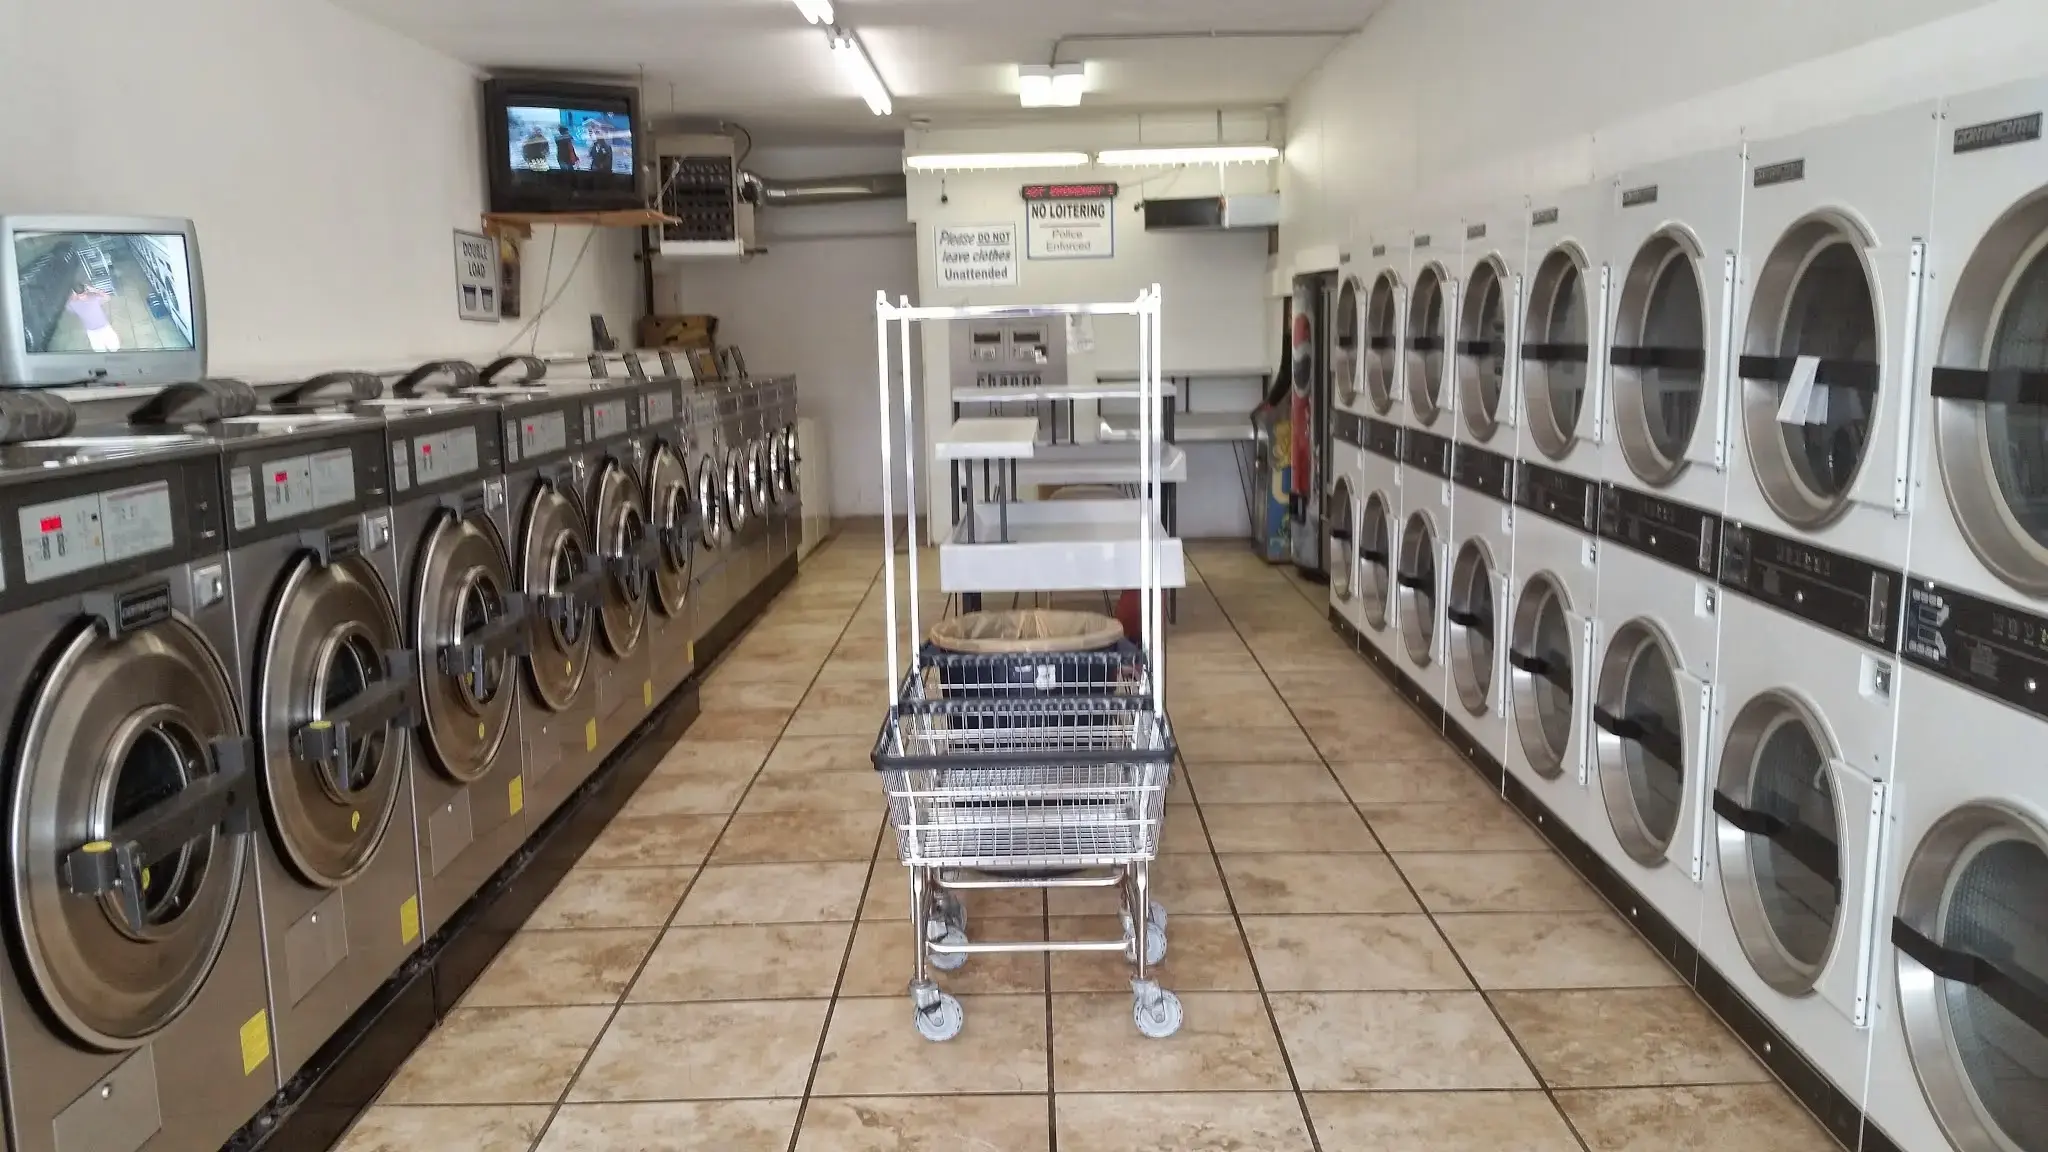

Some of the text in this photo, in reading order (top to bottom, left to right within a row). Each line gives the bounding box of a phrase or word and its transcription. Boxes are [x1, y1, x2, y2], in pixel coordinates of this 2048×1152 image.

[1031, 203, 1105, 219] NO LOITERING
[940, 230, 1010, 246] Please DO NOT
[1052, 229, 1083, 239] Police
[462, 241, 488, 260] DOUBLE
[1046, 241, 1091, 252] Enforced
[943, 247, 1011, 263] leave clothes
[468, 261, 486, 279] LOAD
[944, 266, 1008, 281] Unattended
